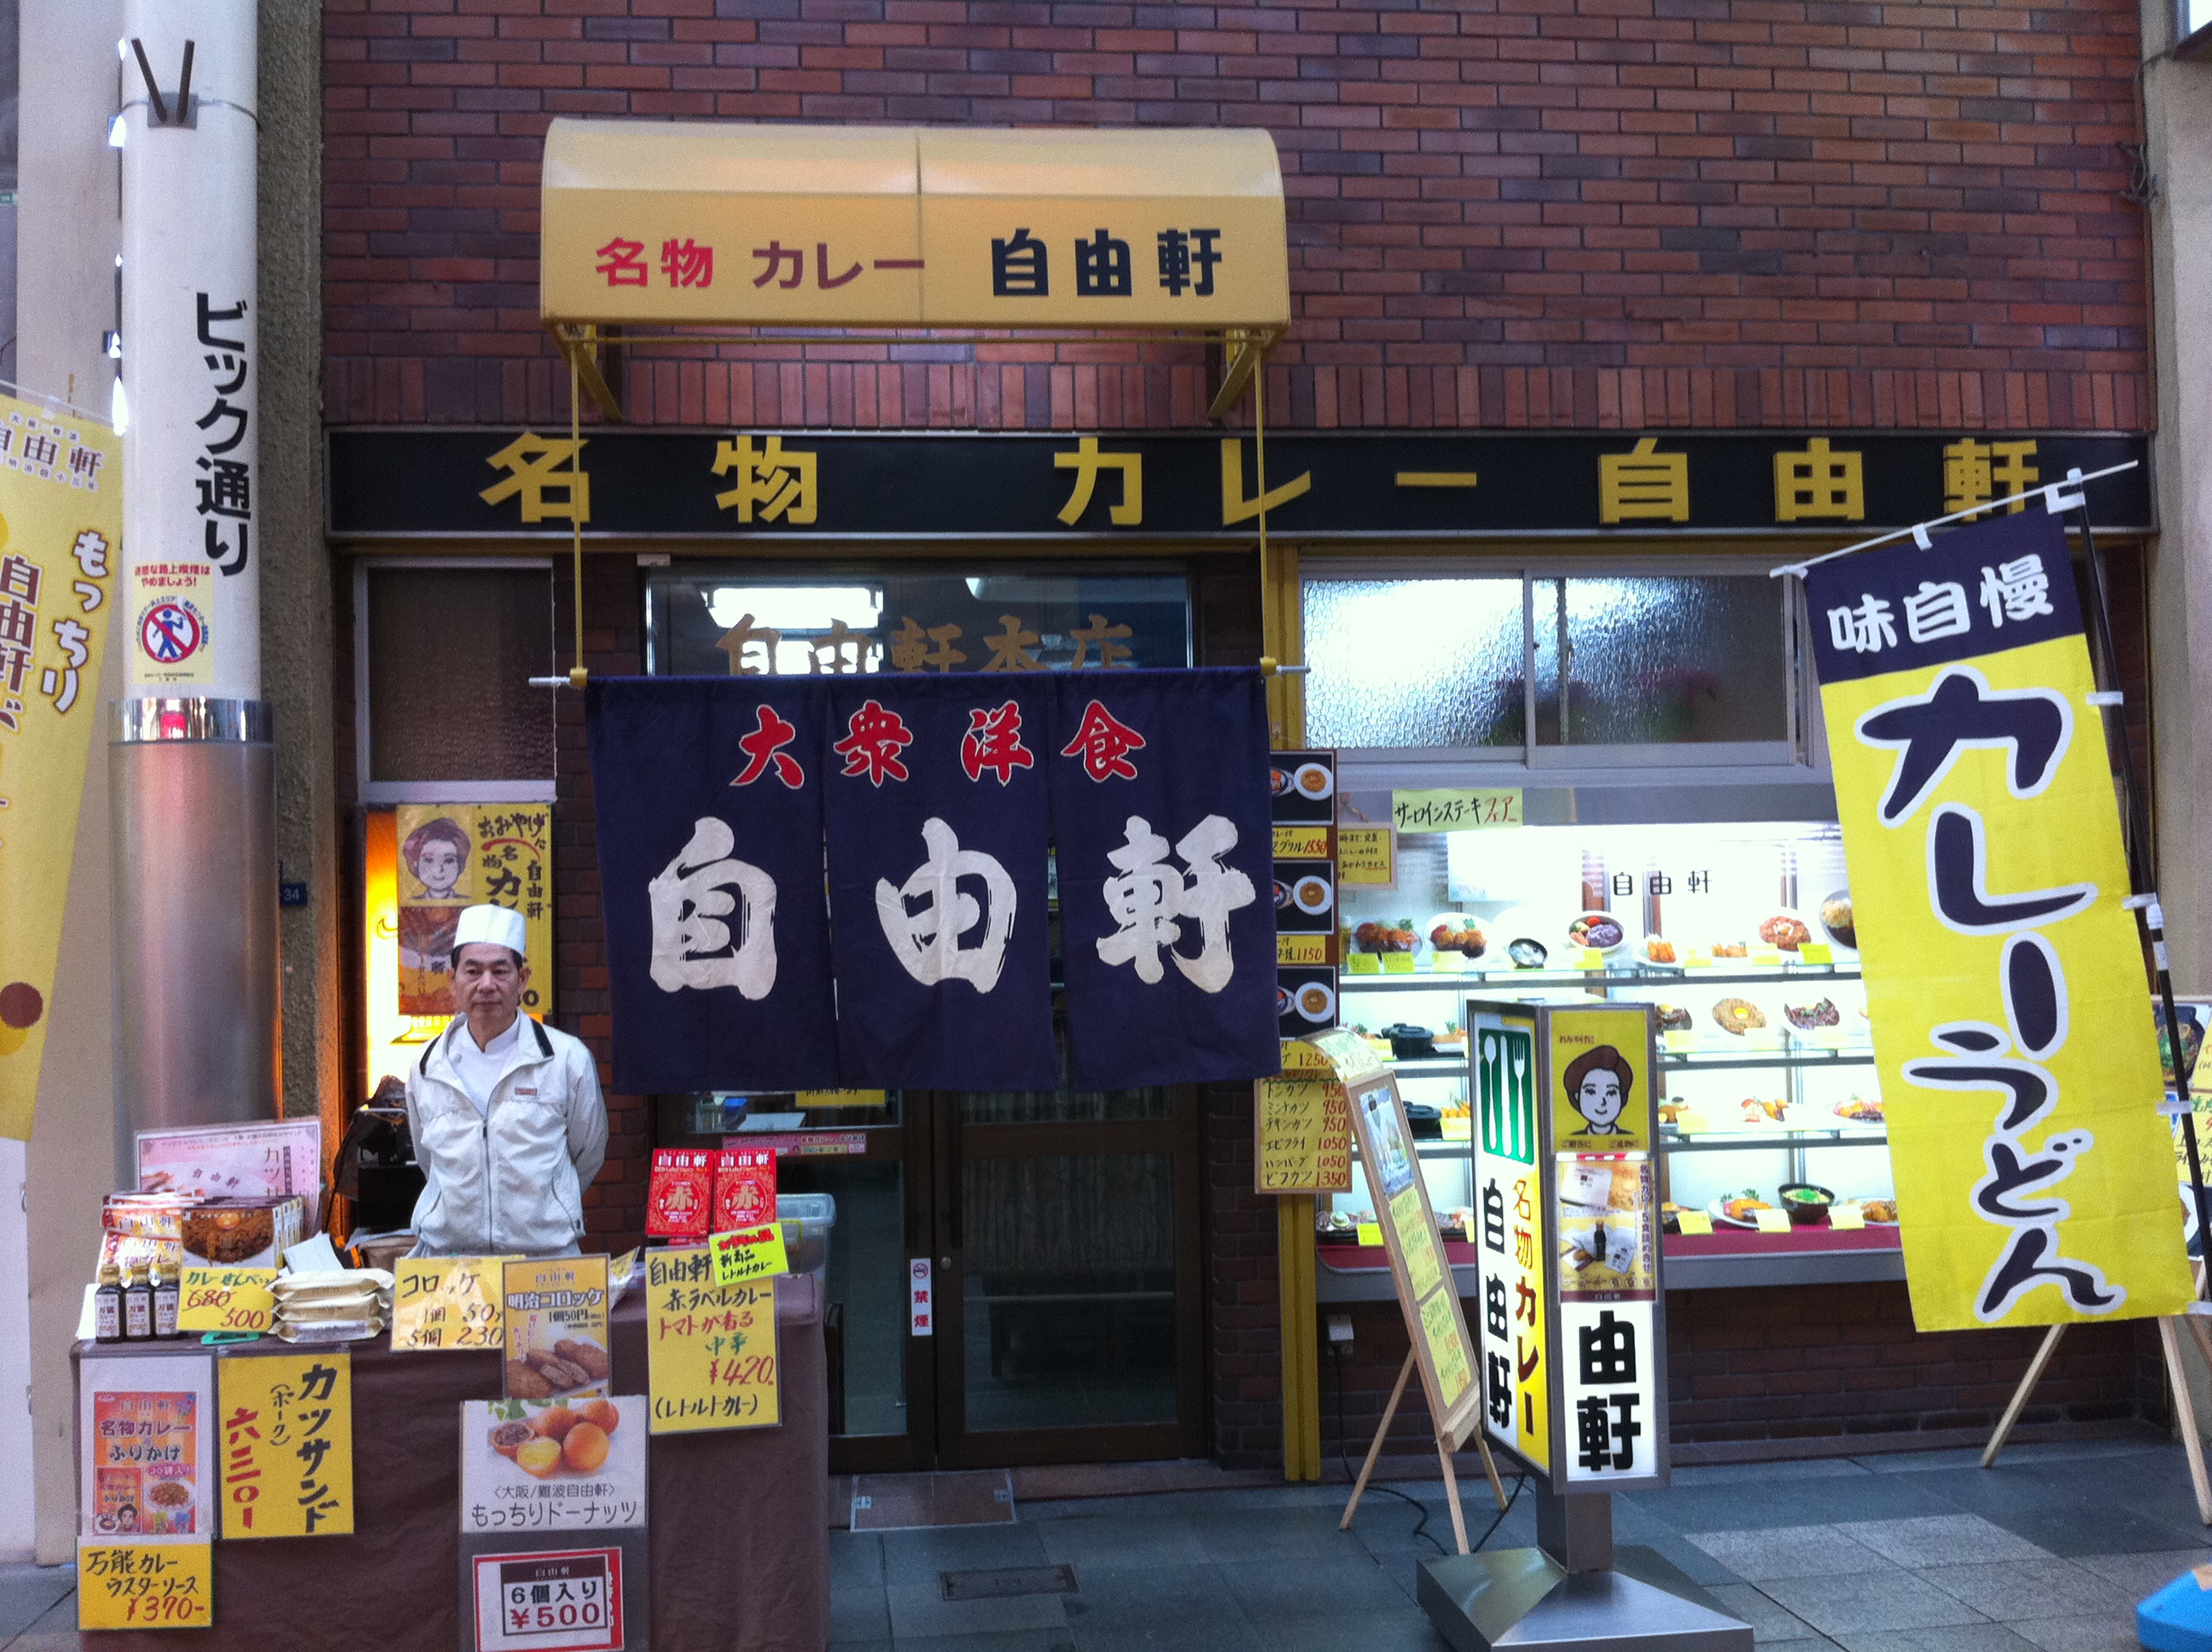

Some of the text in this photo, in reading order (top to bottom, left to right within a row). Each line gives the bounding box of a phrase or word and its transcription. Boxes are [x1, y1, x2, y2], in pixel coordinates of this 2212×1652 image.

[596, 228, 1222, 297] 名物 カレー 自由軒
[195, 292, 251, 576] ビック通り
[1827, 553, 2053, 653] 味自慢
[43, 531, 109, 713] もっちり
[729, 699, 1147, 789] 大衆洋食
[283, 887, 300, 901] 34
[527, 859, 544, 921] 自由軒
[1613, 870, 1712, 896] 自由軒
[648, 812, 1258, 1001] 自由軒
[1854, 664, 2127, 1323] カレーうどん
[1323, 1099, 1347, 1116] 950
[1323, 1116, 1347, 1132] 950
[1317, 1137, 1347, 1151] 1050
[1317, 1155, 1346, 1169] 1050
[1316, 1171, 1347, 1187] 1350
[649, 1254, 712, 1287] 自由軒
[507, 1288, 605, 1311] 明治コロッケ
[663, 1288, 771, 1312] 赤ラベルカレー
[913, 1289, 929, 1329] 禁煙
[1483, 1178, 1512, 1428] 自由軒
[1513, 1179, 1539, 1435] 名物カレー
[220, 1306, 265, 1329] 500
[457, 1326, 504, 1346] 230
[1577, 1310, 1641, 1471] 由軒
[101, 1420, 192, 1436] 名物カレー
[108, 1445, 182, 1462] ふりかけ
[296, 1364, 340, 1533] カツサンド
[472, 1501, 637, 1527] もっちりドーナッツ
[86, 1549, 178, 1576] 万能カレー
[106, 1576, 199, 1597] ウスターソース
[511, 1580, 597, 1604] 6個入り
[509, 1603, 600, 1629] ¥500
